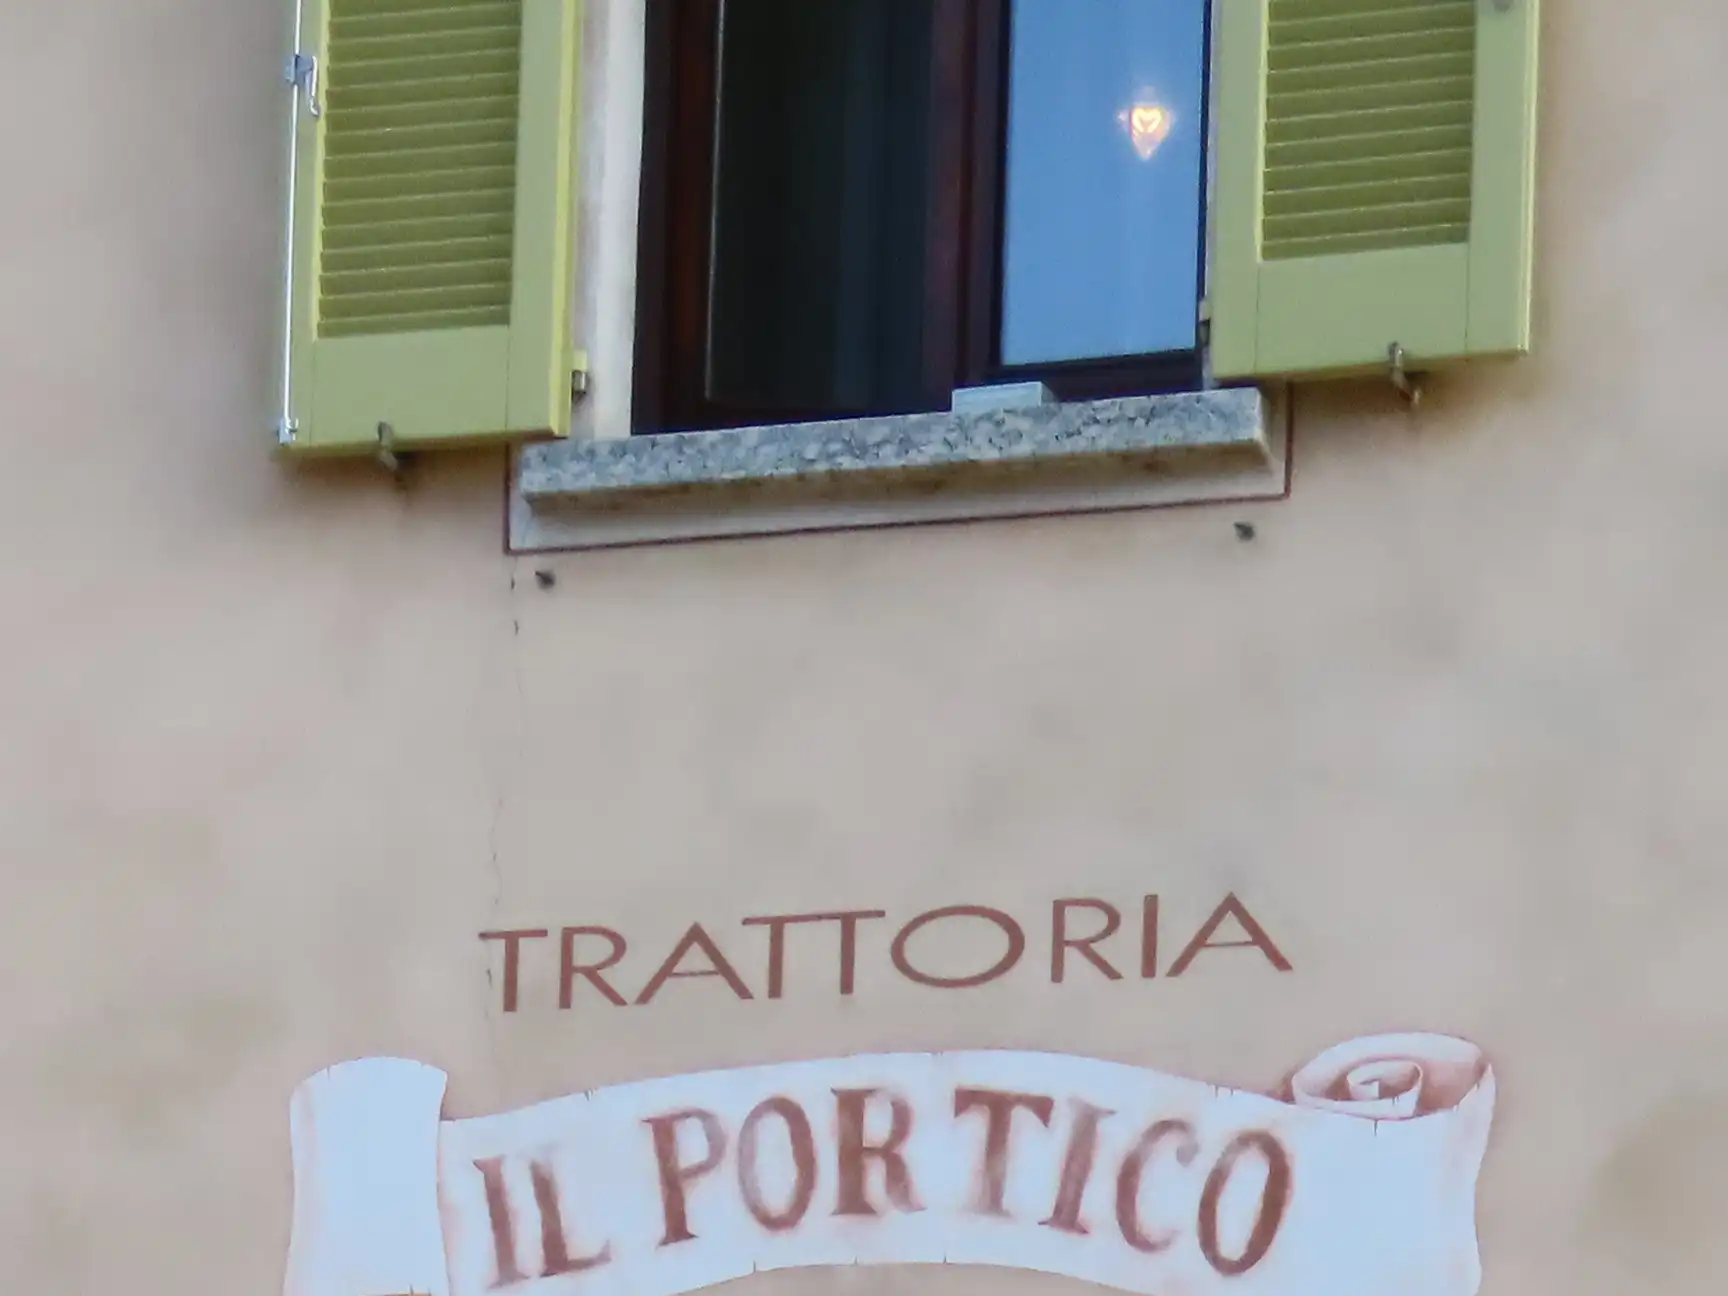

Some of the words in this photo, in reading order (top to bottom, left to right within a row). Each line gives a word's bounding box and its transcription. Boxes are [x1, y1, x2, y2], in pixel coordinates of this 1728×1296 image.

[478, 891, 1295, 1012] TRATTORIA
[471, 1153, 612, 1288] IL
[639, 1085, 1294, 1277] PORTICO
